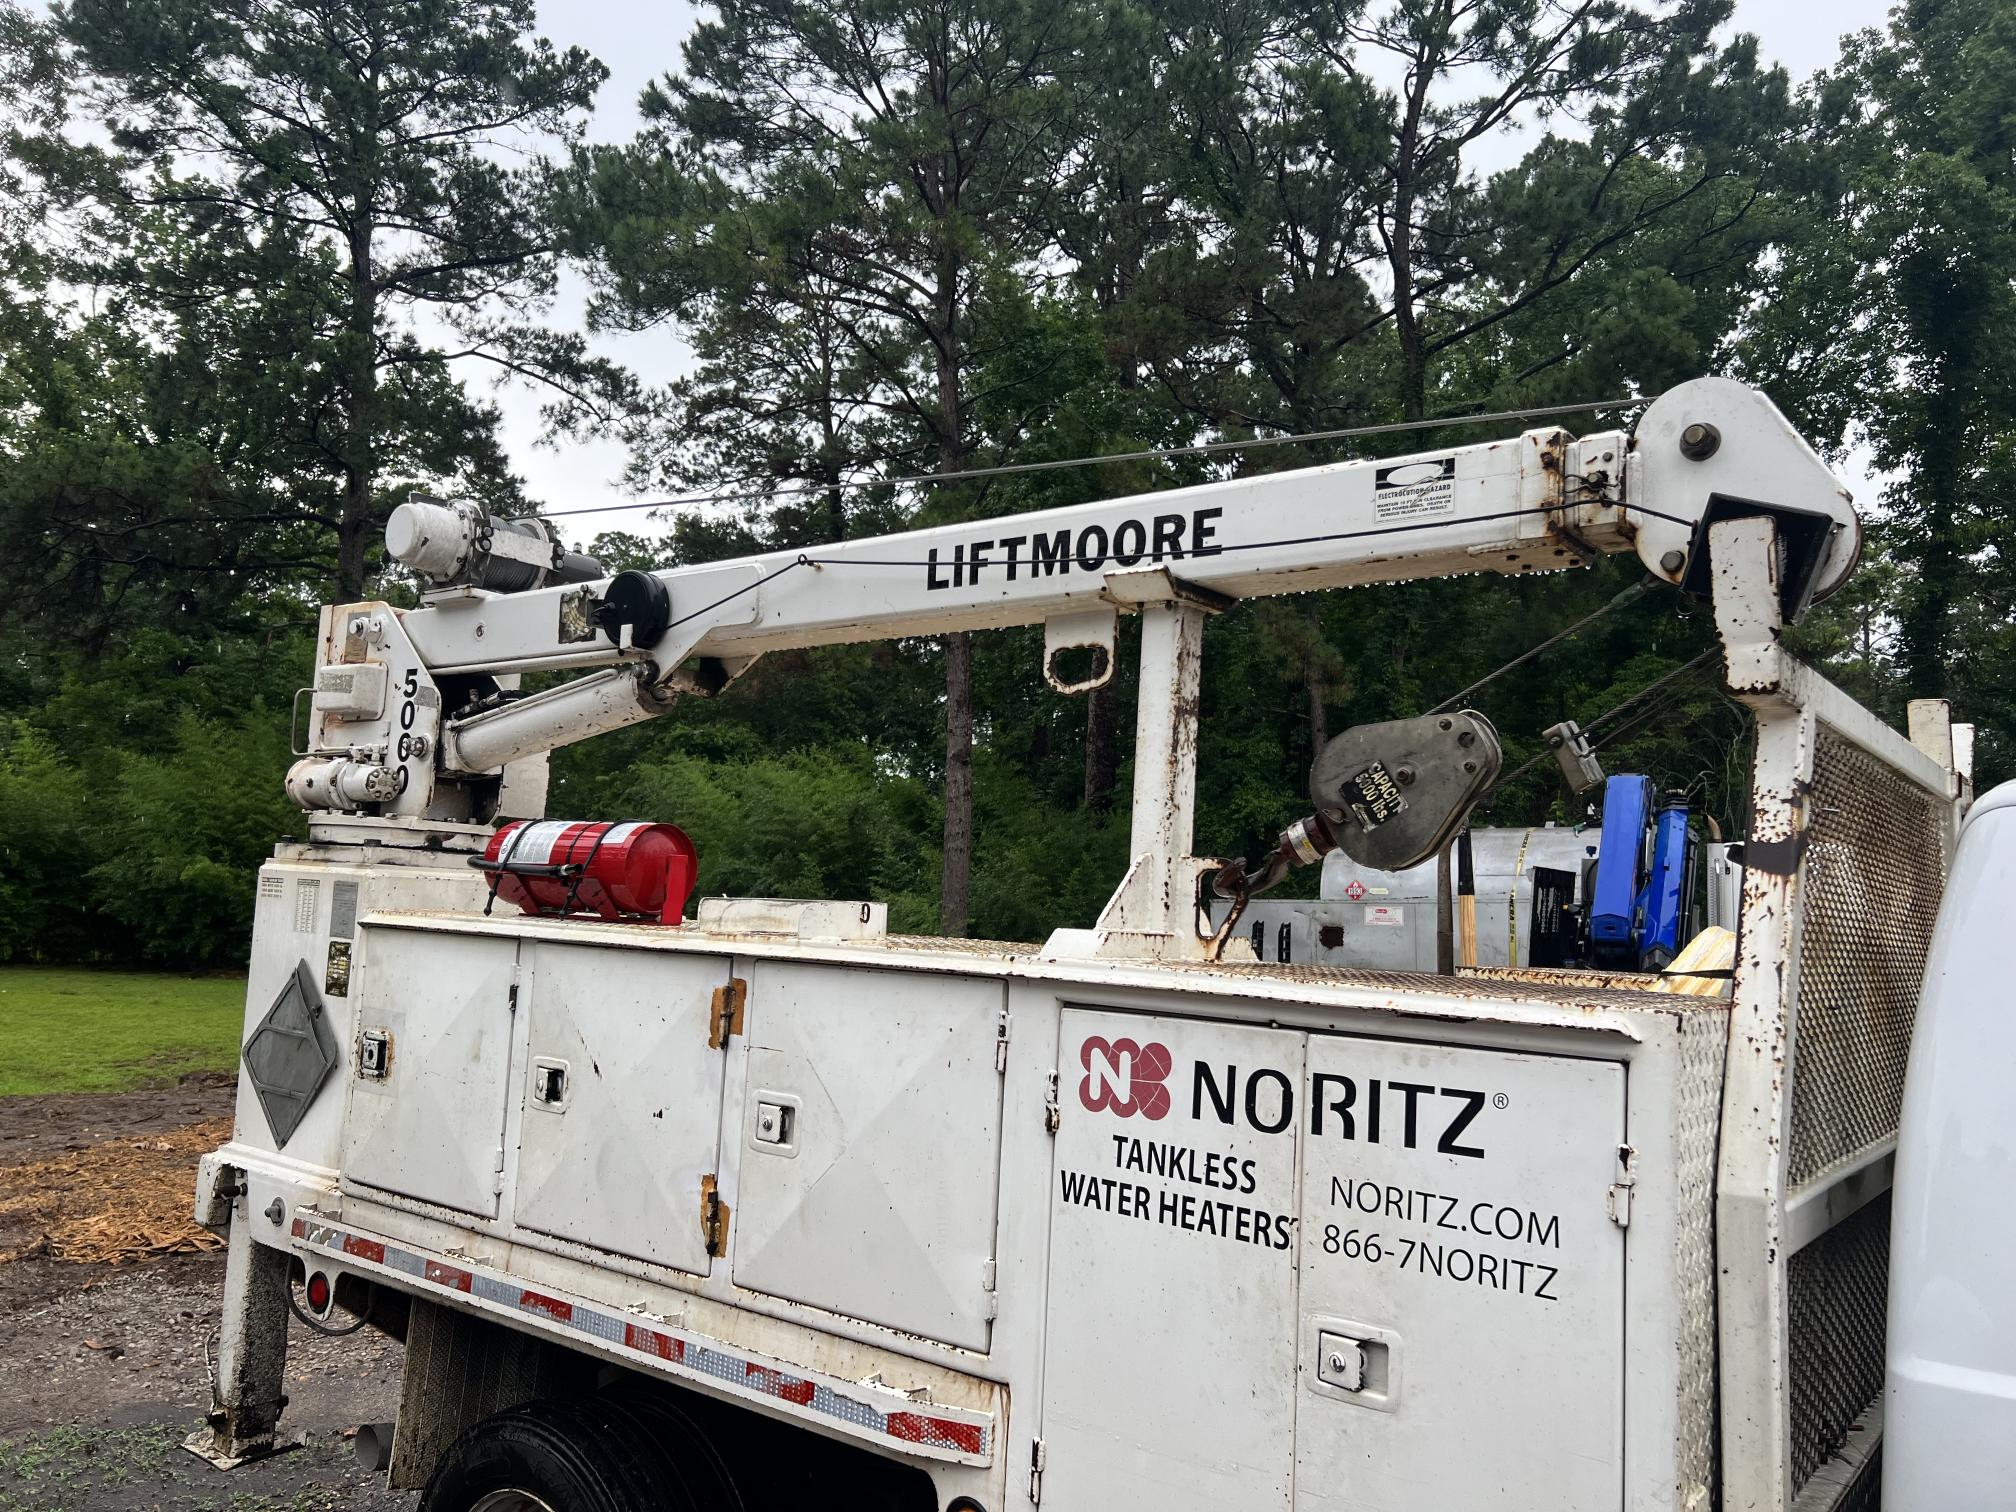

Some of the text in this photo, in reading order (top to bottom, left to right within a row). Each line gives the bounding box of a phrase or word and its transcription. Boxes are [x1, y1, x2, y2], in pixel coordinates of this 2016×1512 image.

[927, 507, 1223, 590] LIFTMOORE
[1113, 1134, 1256, 1194] TANKLESS
[1060, 1170, 1293, 1250] WATER HEATERS
[1330, 1176, 1560, 1249] NORITZ.COM
[1323, 1224, 1559, 1301] 866-7NORITZ
